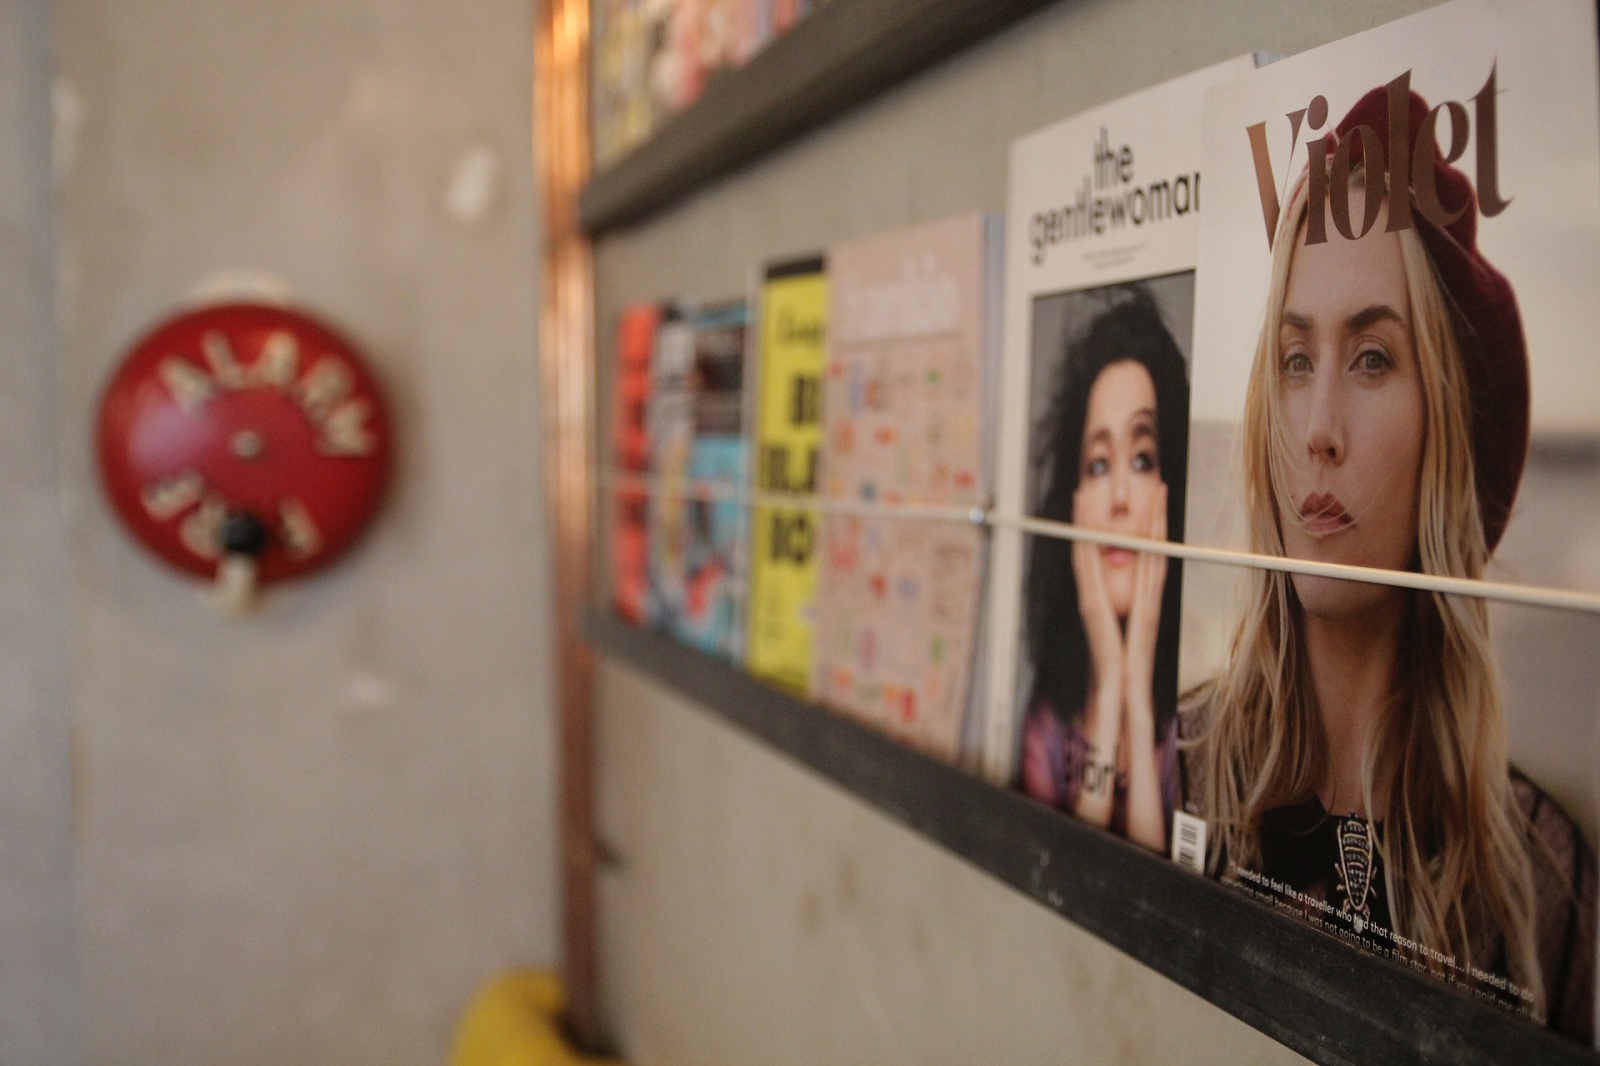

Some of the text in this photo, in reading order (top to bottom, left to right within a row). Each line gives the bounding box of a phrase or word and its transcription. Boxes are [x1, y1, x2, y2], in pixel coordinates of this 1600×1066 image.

[1094, 125, 1134, 190] the
[1246, 52, 1515, 254] Violet
[156, 328, 376, 457] ALARM
[1262, 876, 1269, 888] to
[1270, 877, 1284, 893] feel
[1285, 883, 1296, 899] like
[1298, 894, 1303, 902] a
[1304, 895, 1335, 915] traveller
[1336, 908, 1352, 923] who
[1353, 913, 1369, 930] had
[1370, 921, 1388, 939] that
[1389, 931, 1417, 951] reason
[1419, 943, 1429, 956] to
[1472, 966, 1507, 991] needed
[1509, 982, 1520, 996] to
[1521, 987, 1535, 1003] do
[1308, 915, 1323, 927] was
[1324, 922, 1338, 935] not
[1362, 937, 1371, 949] to
[1372, 939, 1383, 955] be
[1384, 948, 1390, 958] a
